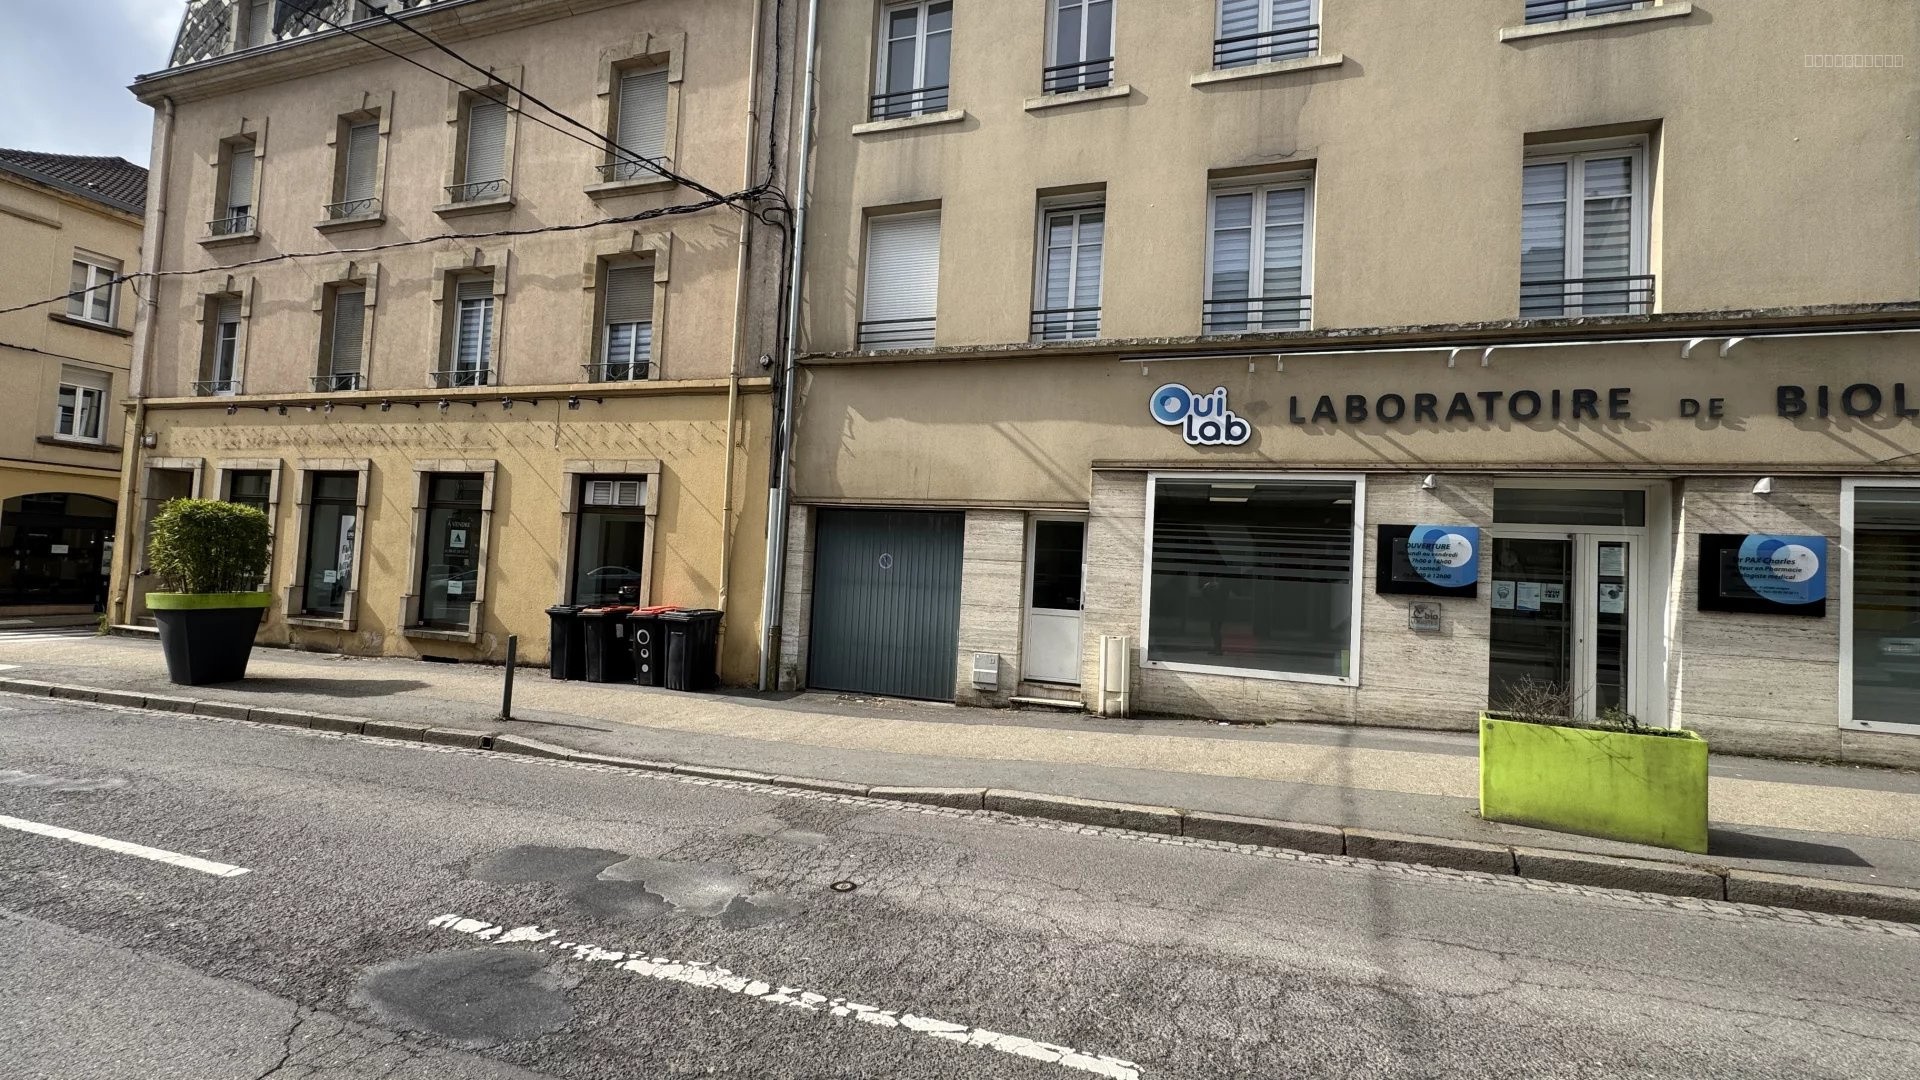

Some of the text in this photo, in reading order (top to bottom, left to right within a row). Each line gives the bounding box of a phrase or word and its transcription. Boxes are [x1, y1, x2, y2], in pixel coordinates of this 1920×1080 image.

[1153, 386, 1223, 422] Oui
[1289, 383, 1920, 424] LABORATOIRE DE BIOL
[1186, 414, 1247, 441] lab
[1405, 542, 1451, 550] OUVERTURE
[1762, 557, 1796, 565] Charles
